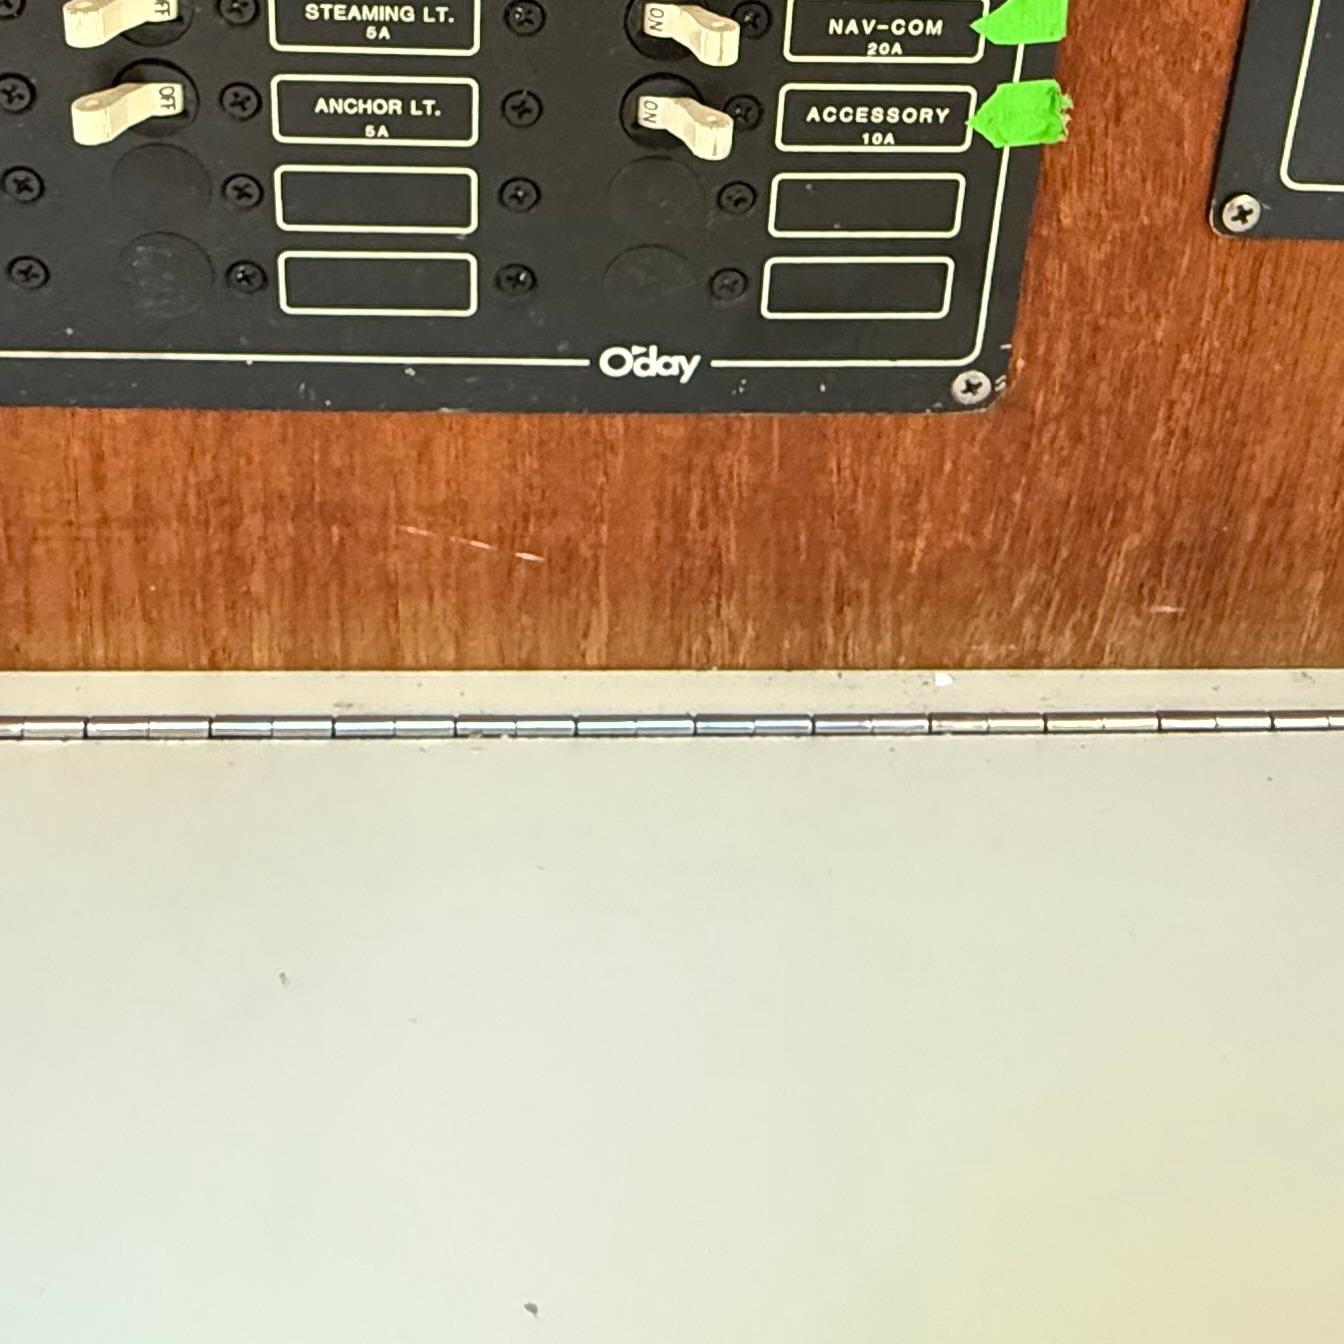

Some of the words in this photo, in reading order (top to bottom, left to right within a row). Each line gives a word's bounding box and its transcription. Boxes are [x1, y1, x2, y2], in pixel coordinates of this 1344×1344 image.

[304, 3, 415, 24] STEAMING
[423, 6, 454, 24] LT.
[649, 7, 664, 33] ON
[366, 26, 391, 41] 5A
[828, 19, 944, 36] NAV-COM
[866, 42, 903, 56] 20A
[158, 85, 176, 111] OFF
[314, 97, 403, 117] ANCHOR
[410, 99, 441, 117] LT.
[643, 99, 658, 124] ON
[805, 106, 950, 123] ACCESSORY
[364, 124, 389, 139] 5A
[861, 132, 896, 145] 10A
